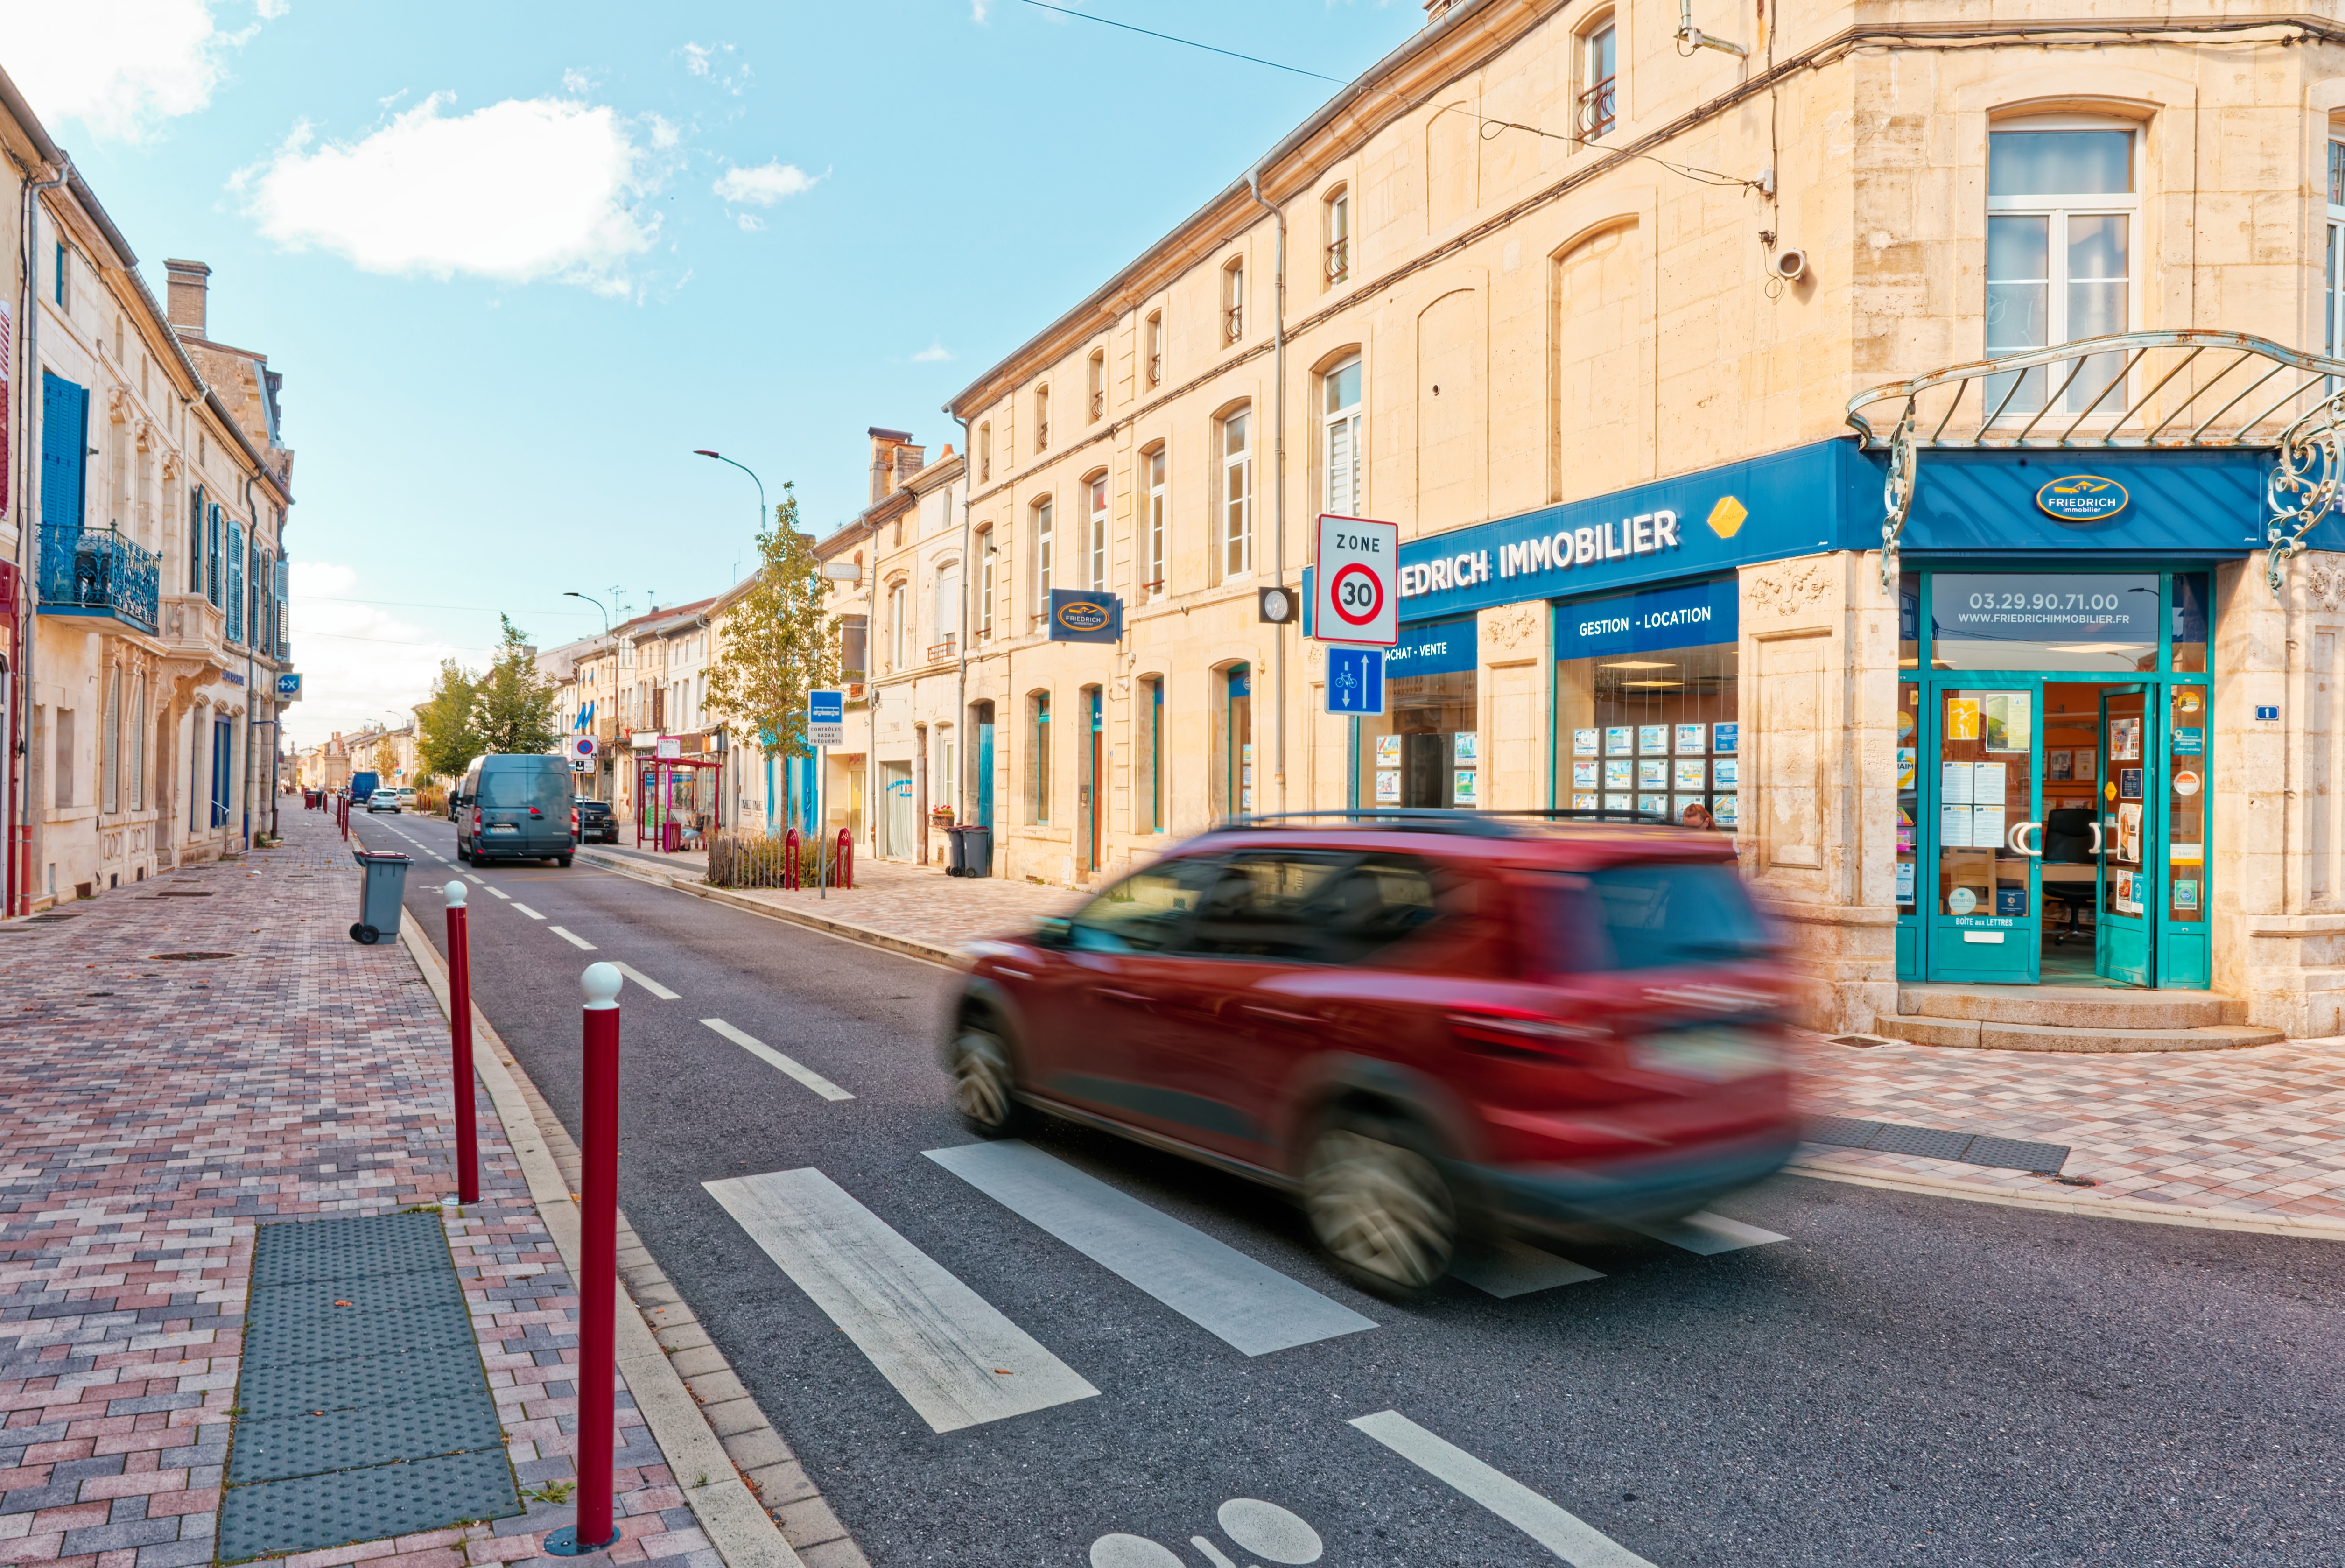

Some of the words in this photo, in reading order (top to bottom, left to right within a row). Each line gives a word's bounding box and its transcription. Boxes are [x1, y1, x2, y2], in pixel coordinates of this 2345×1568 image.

[2049, 498, 2115, 506] FRIEDRICH
[1721, 512, 1744, 521] FNAIM
[1336, 534, 1380, 553] ZONE
[1500, 510, 1678, 578] IMMOBILIER
[1342, 582, 1372, 607] 30
[1969, 593, 2118, 610] 03.29.90.71.00
[1579, 617, 1629, 636] GESTION
[1644, 606, 1711, 628] LOCATION
[1959, 613, 2129, 623] WWW.FRIEDRICHIMMOBILIER.FR
[1385, 647, 1412, 661] ACHAT
[1419, 642, 1447, 657] VENTE
[2265, 708, 2270, 718] 1
[1956, 916, 1973, 925] BOÎTE
